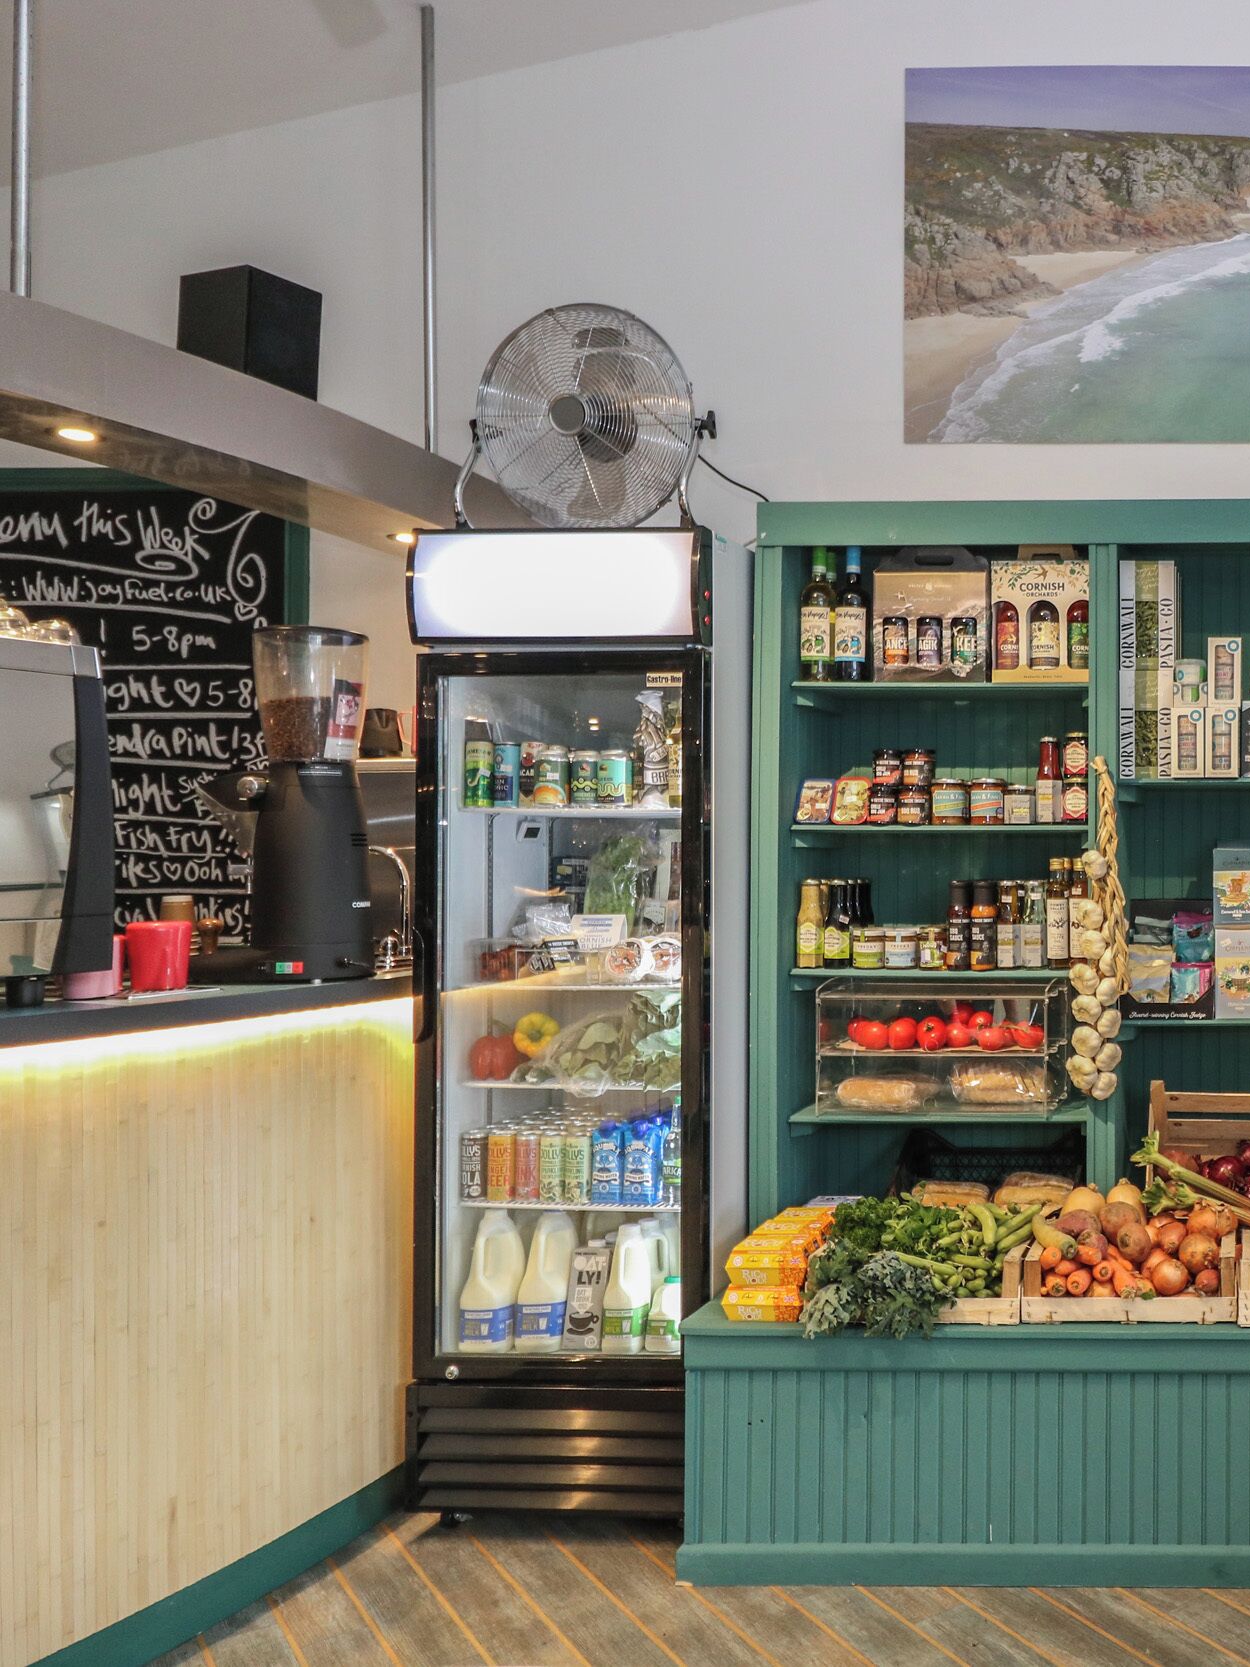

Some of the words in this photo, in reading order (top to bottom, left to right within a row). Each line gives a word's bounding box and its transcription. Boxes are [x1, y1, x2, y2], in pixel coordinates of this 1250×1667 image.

[73, 500, 132, 546] this
[1019, 582, 1065, 592] CORNISH
[132, 625, 216, 659] 5-8pm
[114, 820, 169, 857] Fish
[184, 858, 223, 882] Ooh
[576, 1271, 602, 1286] LY!
